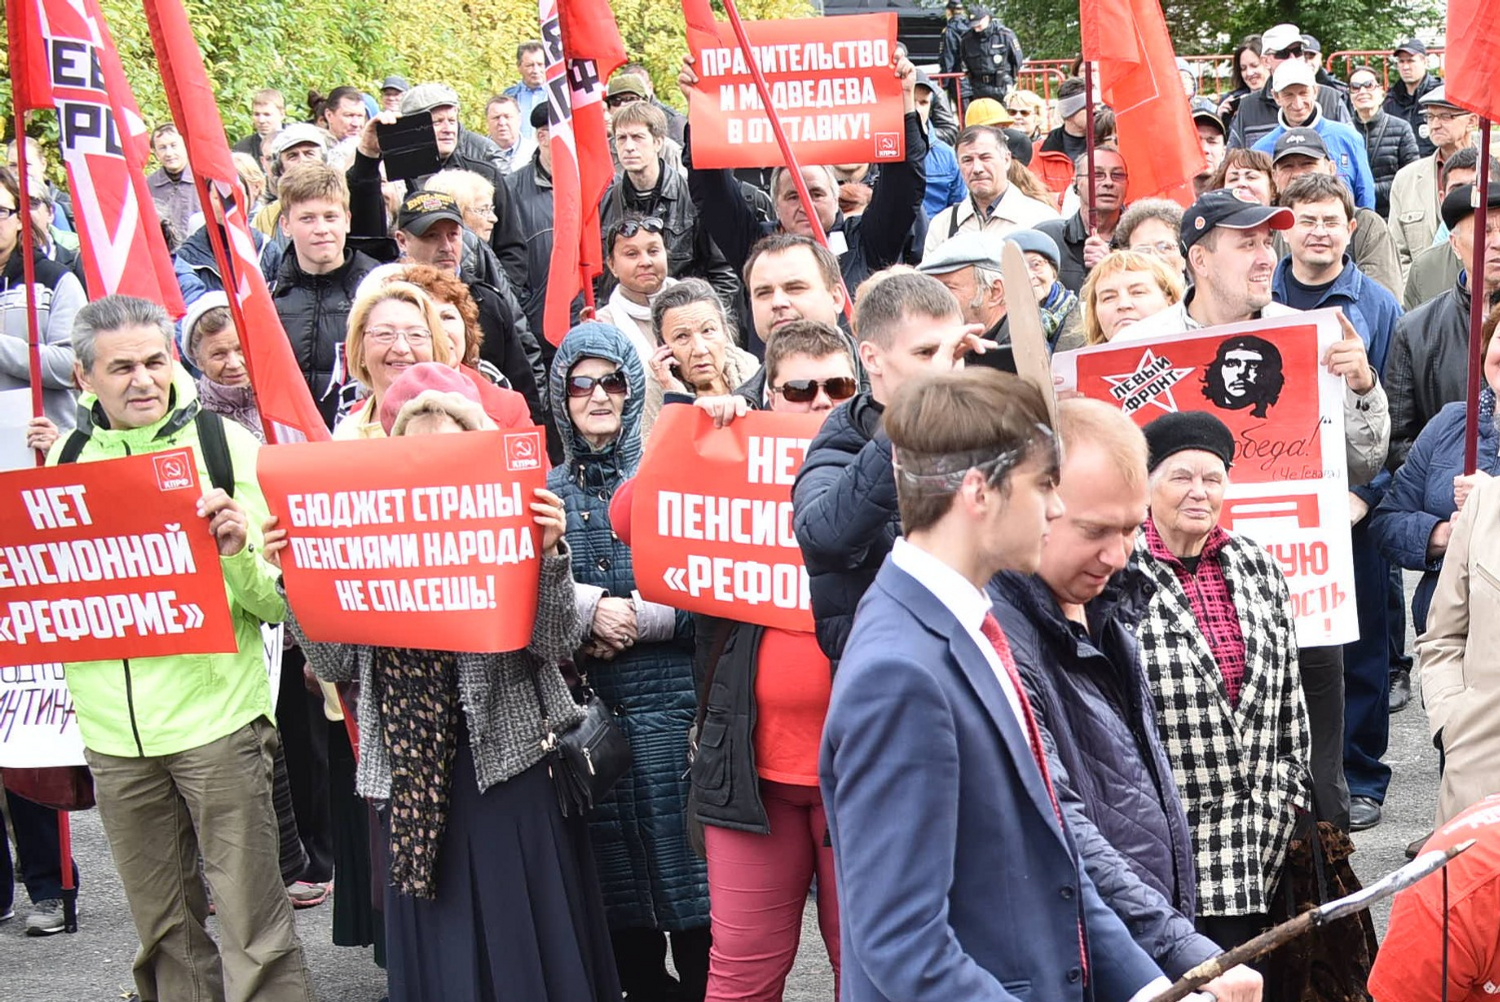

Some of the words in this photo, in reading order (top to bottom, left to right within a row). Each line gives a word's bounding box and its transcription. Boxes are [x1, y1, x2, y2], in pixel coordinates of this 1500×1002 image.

[720, 84, 735, 111] И
[728, 118, 743, 144] В
[1125, 370, 1178, 411] ФРОНТ
[164, 479, 189, 489] КПРФ
[512, 459, 538, 468] КПРФ
[21, 484, 93, 530] НЕТ
[287, 489, 406, 528] БЮДЖЕТ
[411, 482, 523, 522] СТРАНЫ
[657, 490, 800, 548] ПЕНСИО
[290, 533, 419, 569] ПЕНСИЯМИ
[423, 526, 535, 566] НАРОДА
[334, 579, 369, 611] НЕ
[367, 575, 497, 611] СПАСЕШЬ!
[0, 590, 205, 645] «РЕФОРМЕ»
